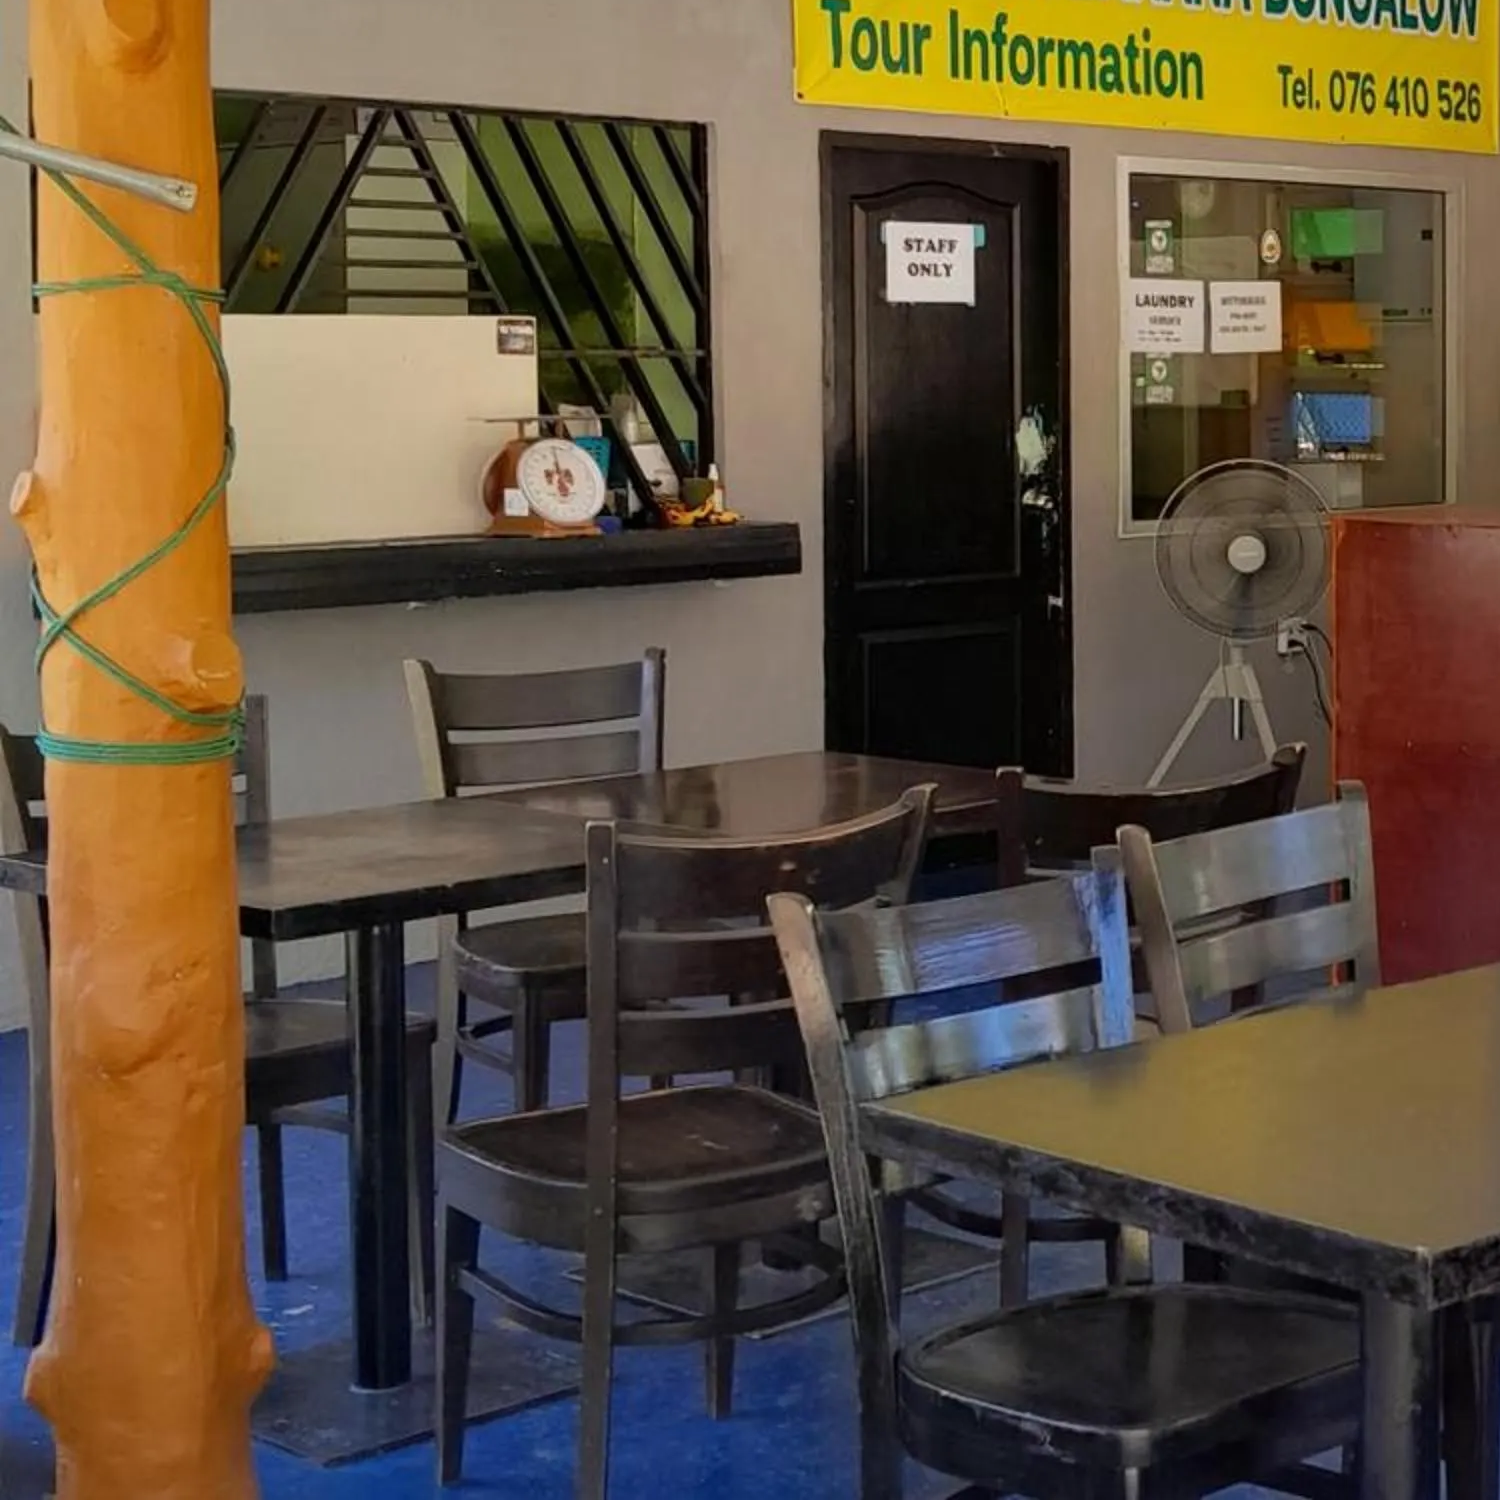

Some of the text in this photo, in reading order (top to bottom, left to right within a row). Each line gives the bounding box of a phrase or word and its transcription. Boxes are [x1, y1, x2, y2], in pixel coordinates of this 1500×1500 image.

[949, 9, 1204, 101] Information
[1277, 65, 1481, 123] Tel. 076 410 526
[902, 238, 958, 253] STAFF
[907, 262, 952, 277] ONLY
[1135, 293, 1195, 309] LAUNDRY
